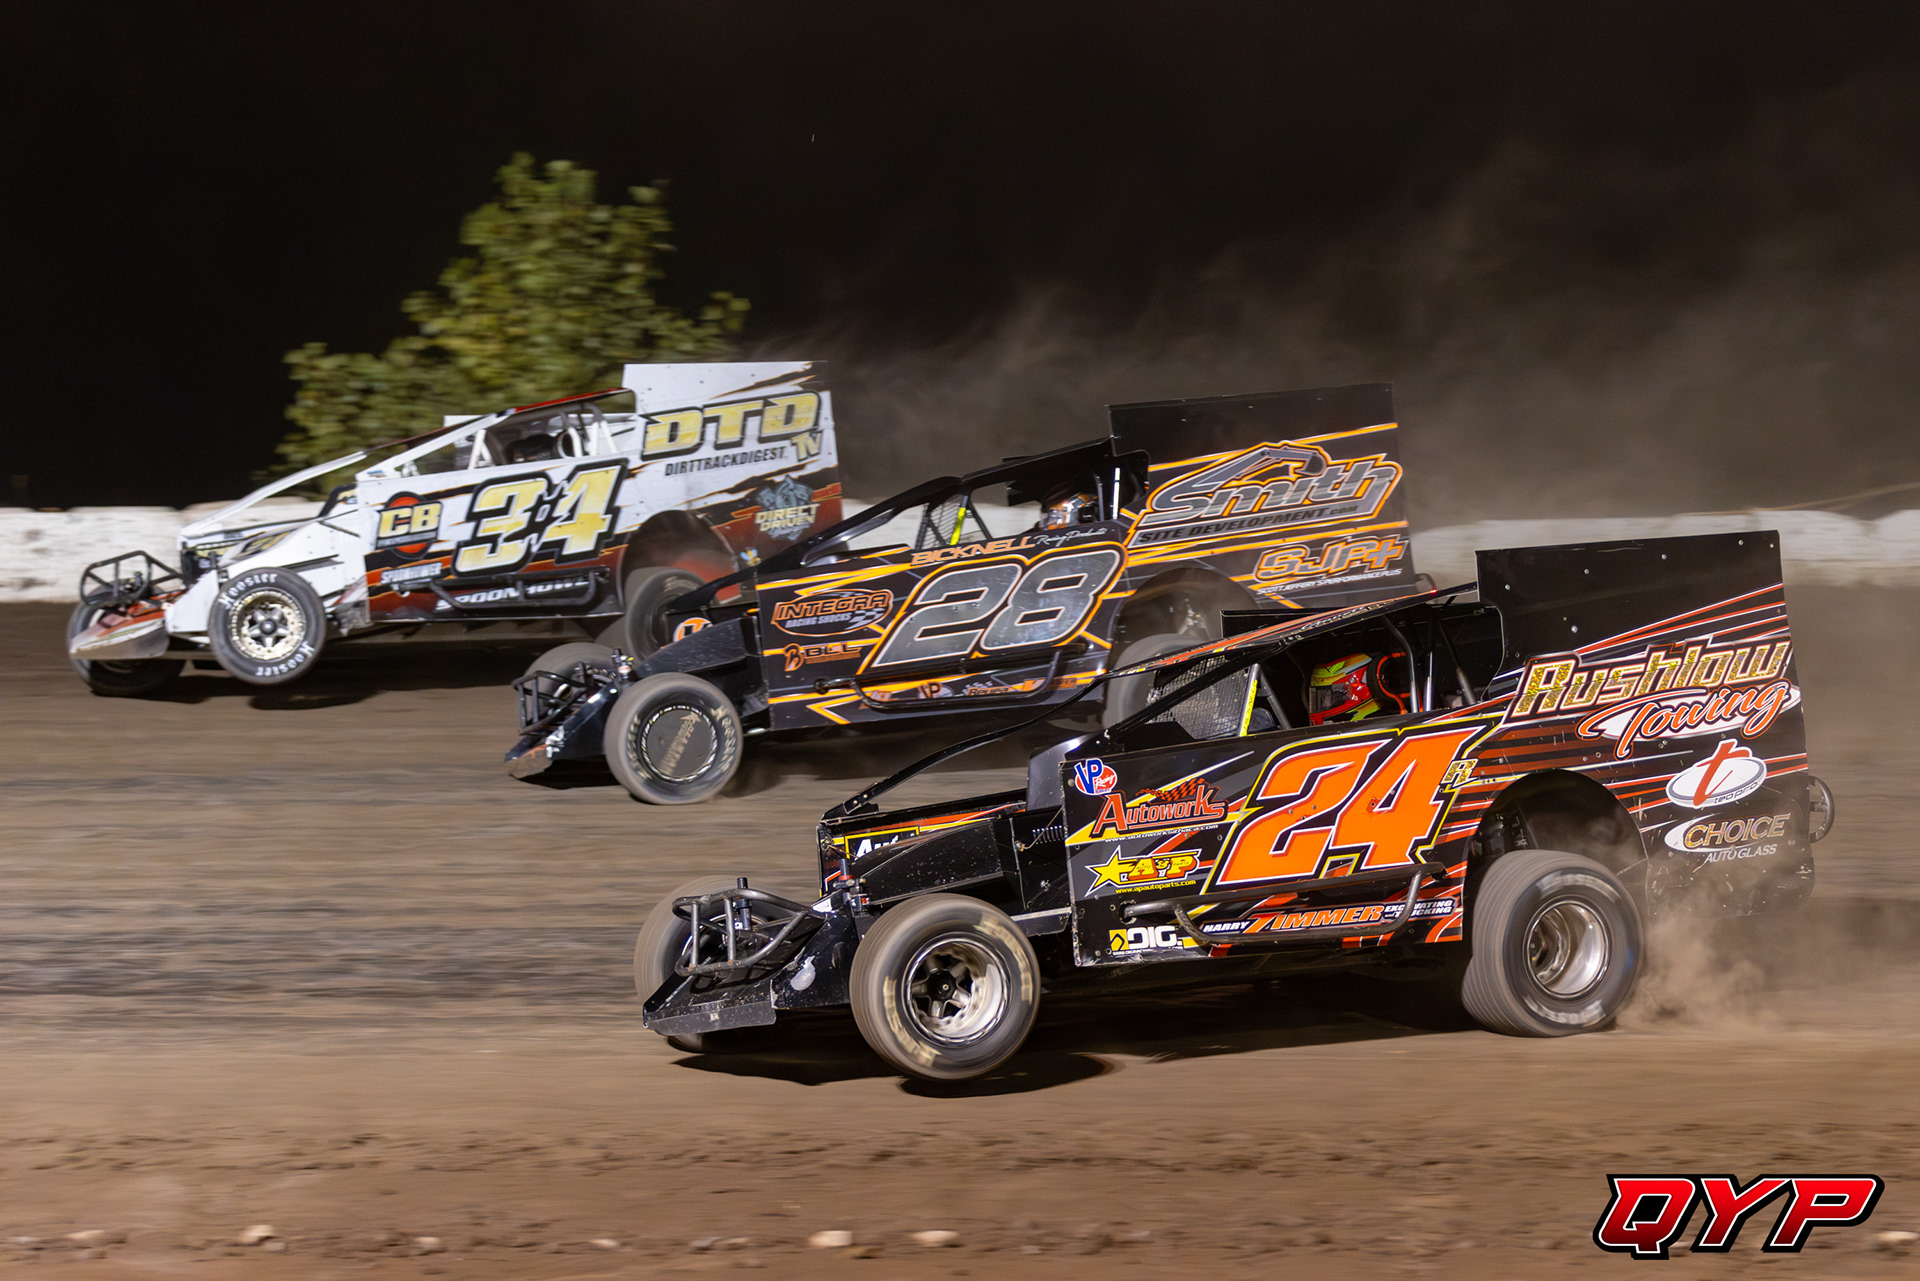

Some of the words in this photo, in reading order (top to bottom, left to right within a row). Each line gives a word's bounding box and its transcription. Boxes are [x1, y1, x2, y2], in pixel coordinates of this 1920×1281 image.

[642, 391, 821, 459] DTD
[791, 431, 822, 462] TV
[1138, 458, 1398, 527] Smith
[377, 503, 442, 538] CB
[455, 464, 622, 573] 34
[755, 503, 820, 524] DIRECT
[911, 536, 1036, 565] BICKNELL
[1139, 526, 1182, 543] SITE
[776, 592, 889, 620] INTEGRA
[870, 548, 1121, 668] 28
[1511, 639, 1793, 718] Rushlow
[1576, 680, 1791, 757] Towing
[1073, 758, 1104, 794] VP
[1092, 785, 1225, 835] Autoworks
[1216, 725, 1487, 885] 24
[1684, 813, 1791, 848] CHOICE
[1704, 850, 1737, 863] AUTO
[1737, 844, 1778, 859] GLASS
[1203, 920, 1249, 933] HARRY
[1244, 904, 1385, 934] ZIMMER
[1385, 900, 1453, 912] EXCVATING
[1395, 906, 1452, 918] TUCKING
